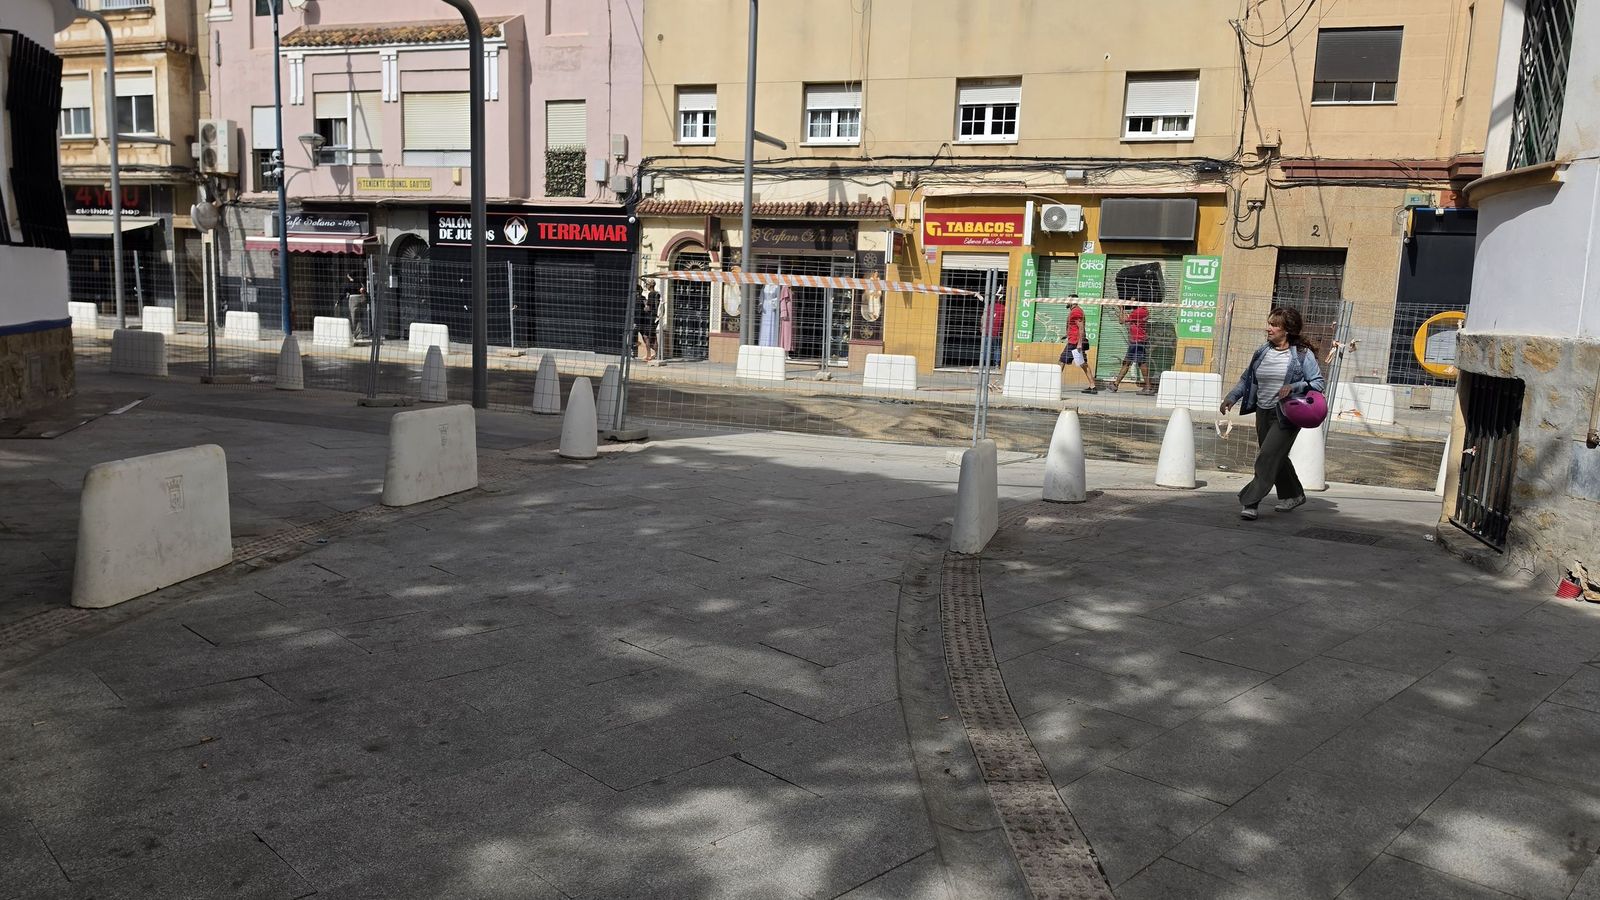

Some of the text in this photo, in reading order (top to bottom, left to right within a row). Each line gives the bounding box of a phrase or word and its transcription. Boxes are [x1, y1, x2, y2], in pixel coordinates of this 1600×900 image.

[362, 180, 386, 188] TENIENTE
[119, 208, 140, 216] hop
[304, 216, 336, 227] Solano
[439, 215, 472, 229] SALÓN
[537, 222, 628, 242] TERRAMAR
[946, 221, 1015, 233] TABACOS
[1311, 224, 1321, 237] 2
[440, 228, 495, 241] DE JUES
[1080, 262, 1104, 271] ORO
[1181, 297, 1215, 307] dinero
[1180, 309, 1214, 318] banco
[1189, 323, 1213, 333] da
